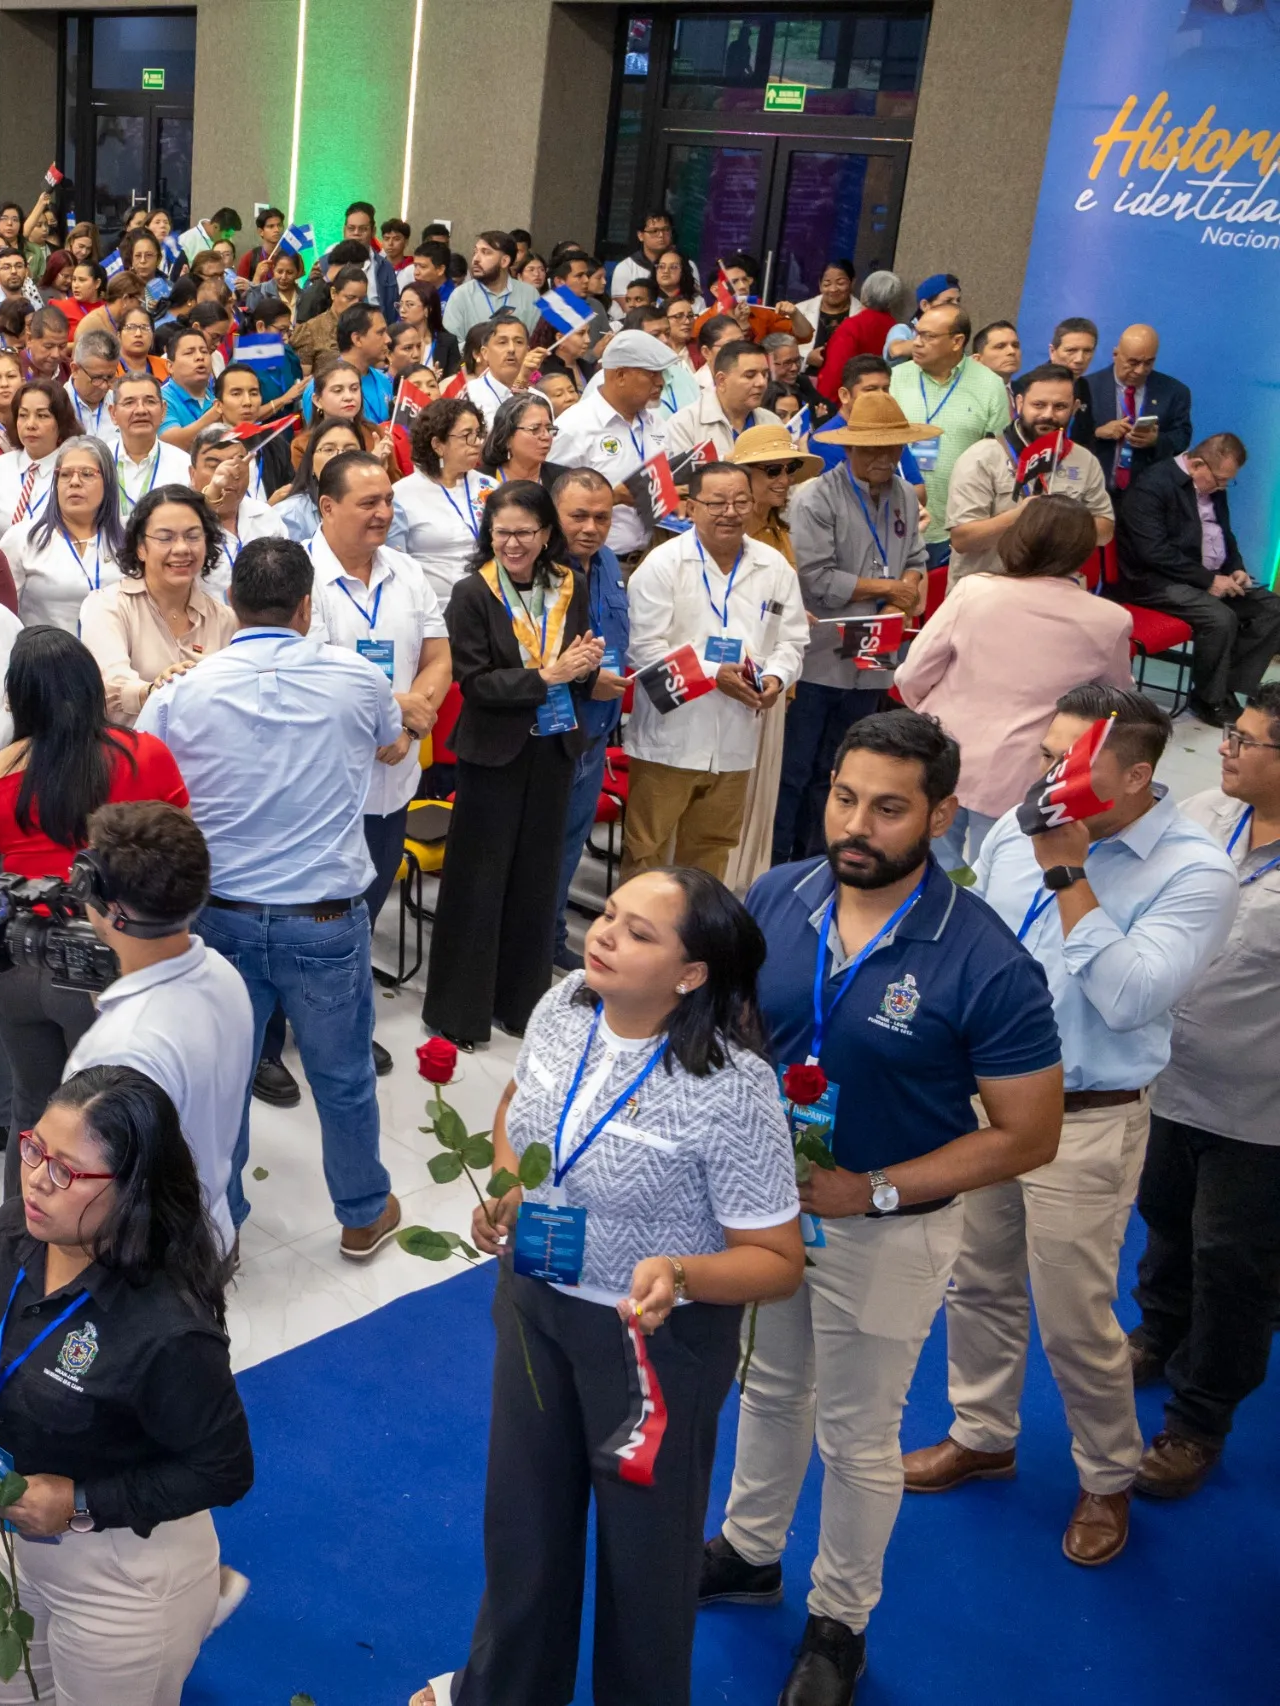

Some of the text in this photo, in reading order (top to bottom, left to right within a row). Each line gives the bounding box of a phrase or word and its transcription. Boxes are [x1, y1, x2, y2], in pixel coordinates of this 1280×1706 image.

[1074, 156, 1280, 223] e identida
[1200, 226, 1280, 250] Nacion
[640, 464, 668, 519] FSLN
[657, 659, 689, 705] FSL
[1038, 746, 1074, 827] SLN
